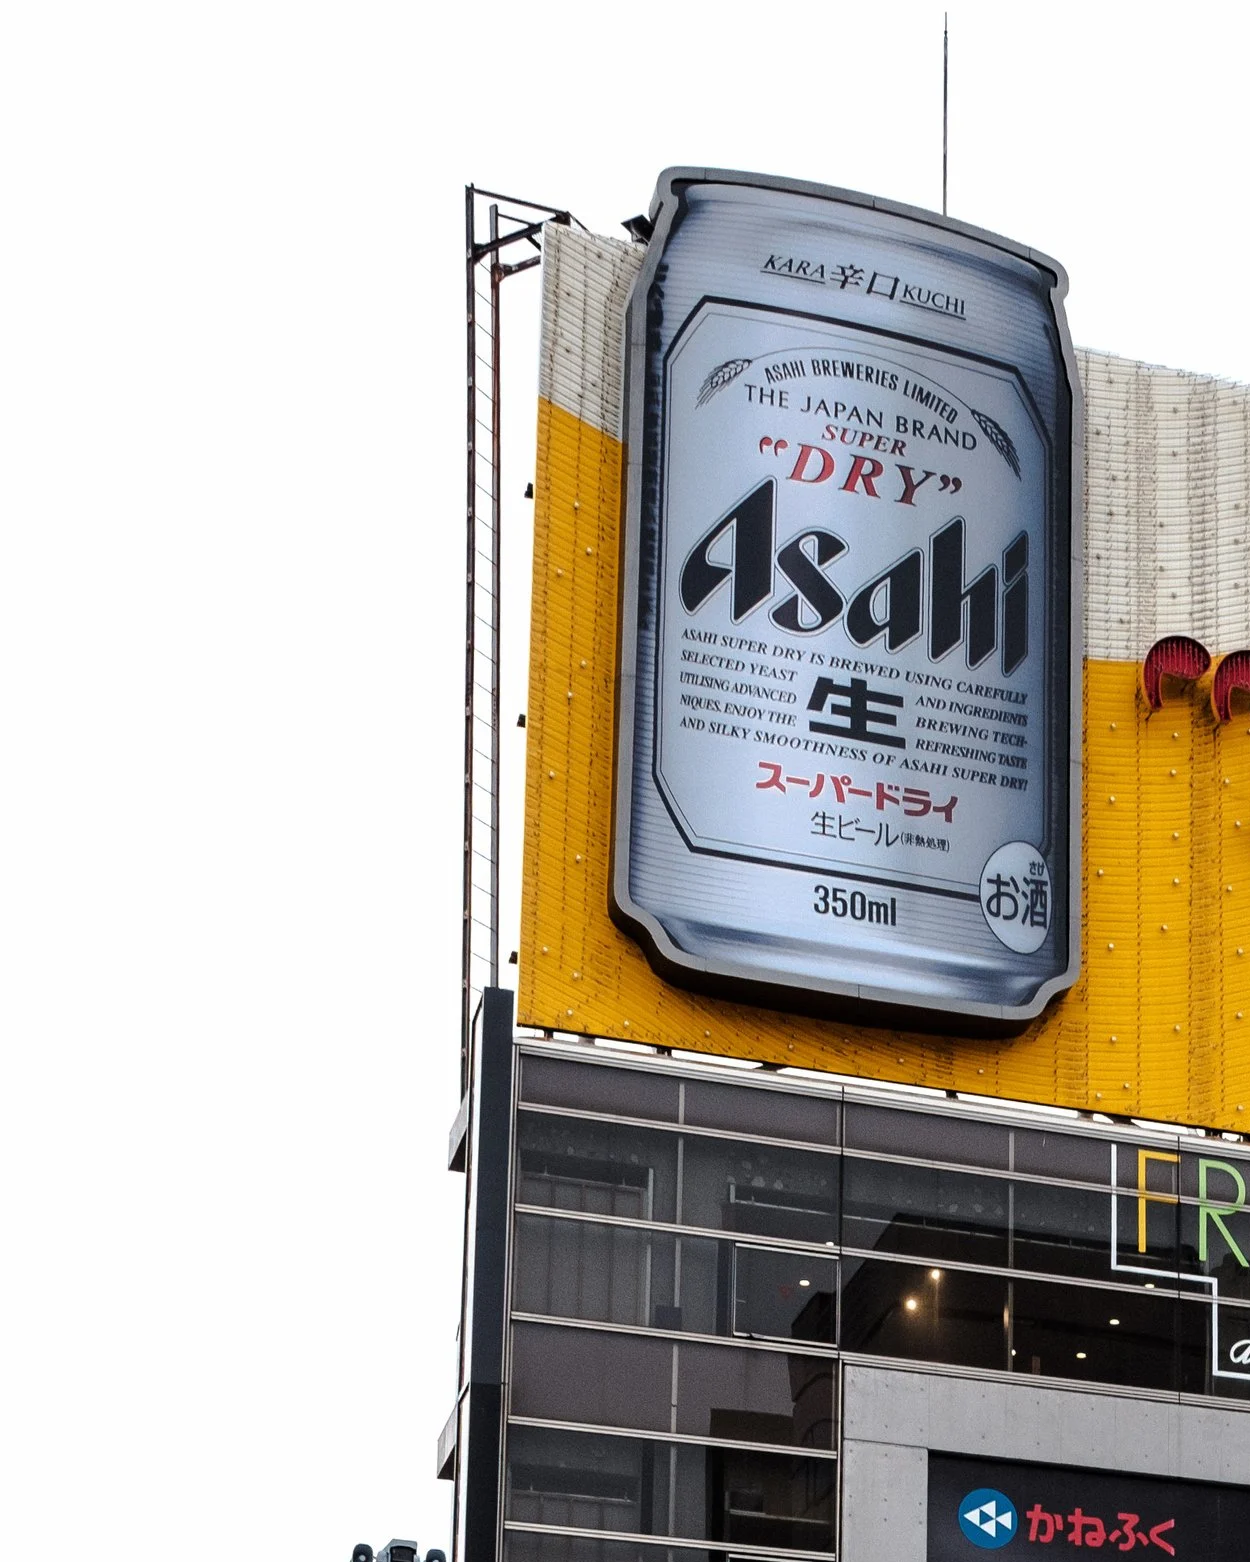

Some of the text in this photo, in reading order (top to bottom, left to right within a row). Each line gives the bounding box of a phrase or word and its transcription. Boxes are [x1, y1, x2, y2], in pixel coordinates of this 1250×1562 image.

[763, 255, 825, 279] KARA
[830, 264, 900, 300] 辛口
[903, 284, 966, 316] KUCHI
[744, 383, 977, 450] THE JAPAN BRAND
[765, 358, 958, 425] ASAHI BREWERIES LIMITED
[822, 424, 907, 457] SUPER
[679, 476, 1029, 678] Asahi
[680, 649, 1029, 727] SELECTED YEAST AND INGREDIENTS
[681, 628, 1029, 705] ASAHI SUPER DRY IS BREWED USING CAREFULLY
[679, 671, 1028, 749] UTILISING ADVANCED BREWING TECH-
[724, 702, 766, 720] ENJOY
[767, 711, 797, 727] THE
[915, 738, 997, 764] REFRESHING
[997, 753, 1028, 770] TASTE
[806, 676, 907, 750] 生
[680, 716, 1029, 792] AND SILKY SMOOTHNESS OF ASAHI SUPER DRY!
[755, 761, 959, 824] スーパードライ
[813, 884, 897, 927] 350ml
[986, 873, 1048, 930] お酒
[1026, 1501, 1176, 1557] かねふく
